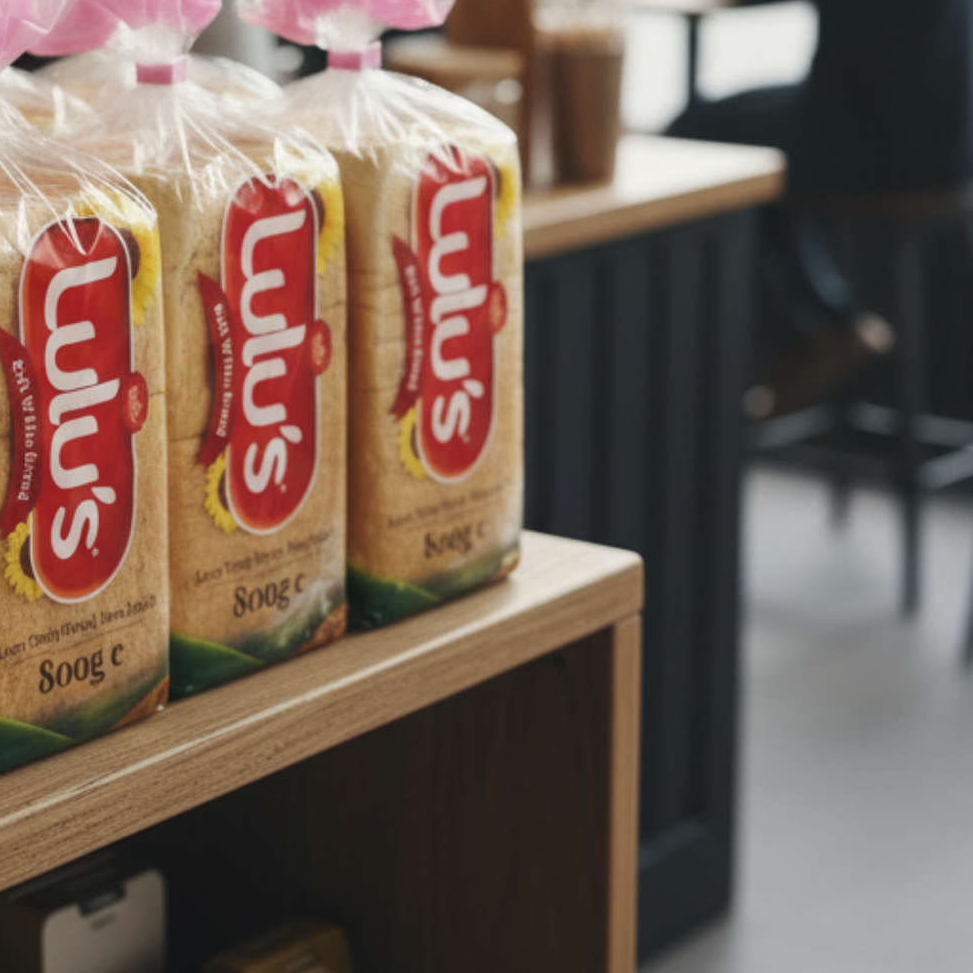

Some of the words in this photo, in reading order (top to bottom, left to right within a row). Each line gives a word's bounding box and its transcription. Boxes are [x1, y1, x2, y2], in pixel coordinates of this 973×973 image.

[45, 256, 120, 560] Lulu's
[240, 210, 306, 494] Lulu's
[428, 176, 487, 443] Lulu's
[39, 646, 105, 694] 800g
